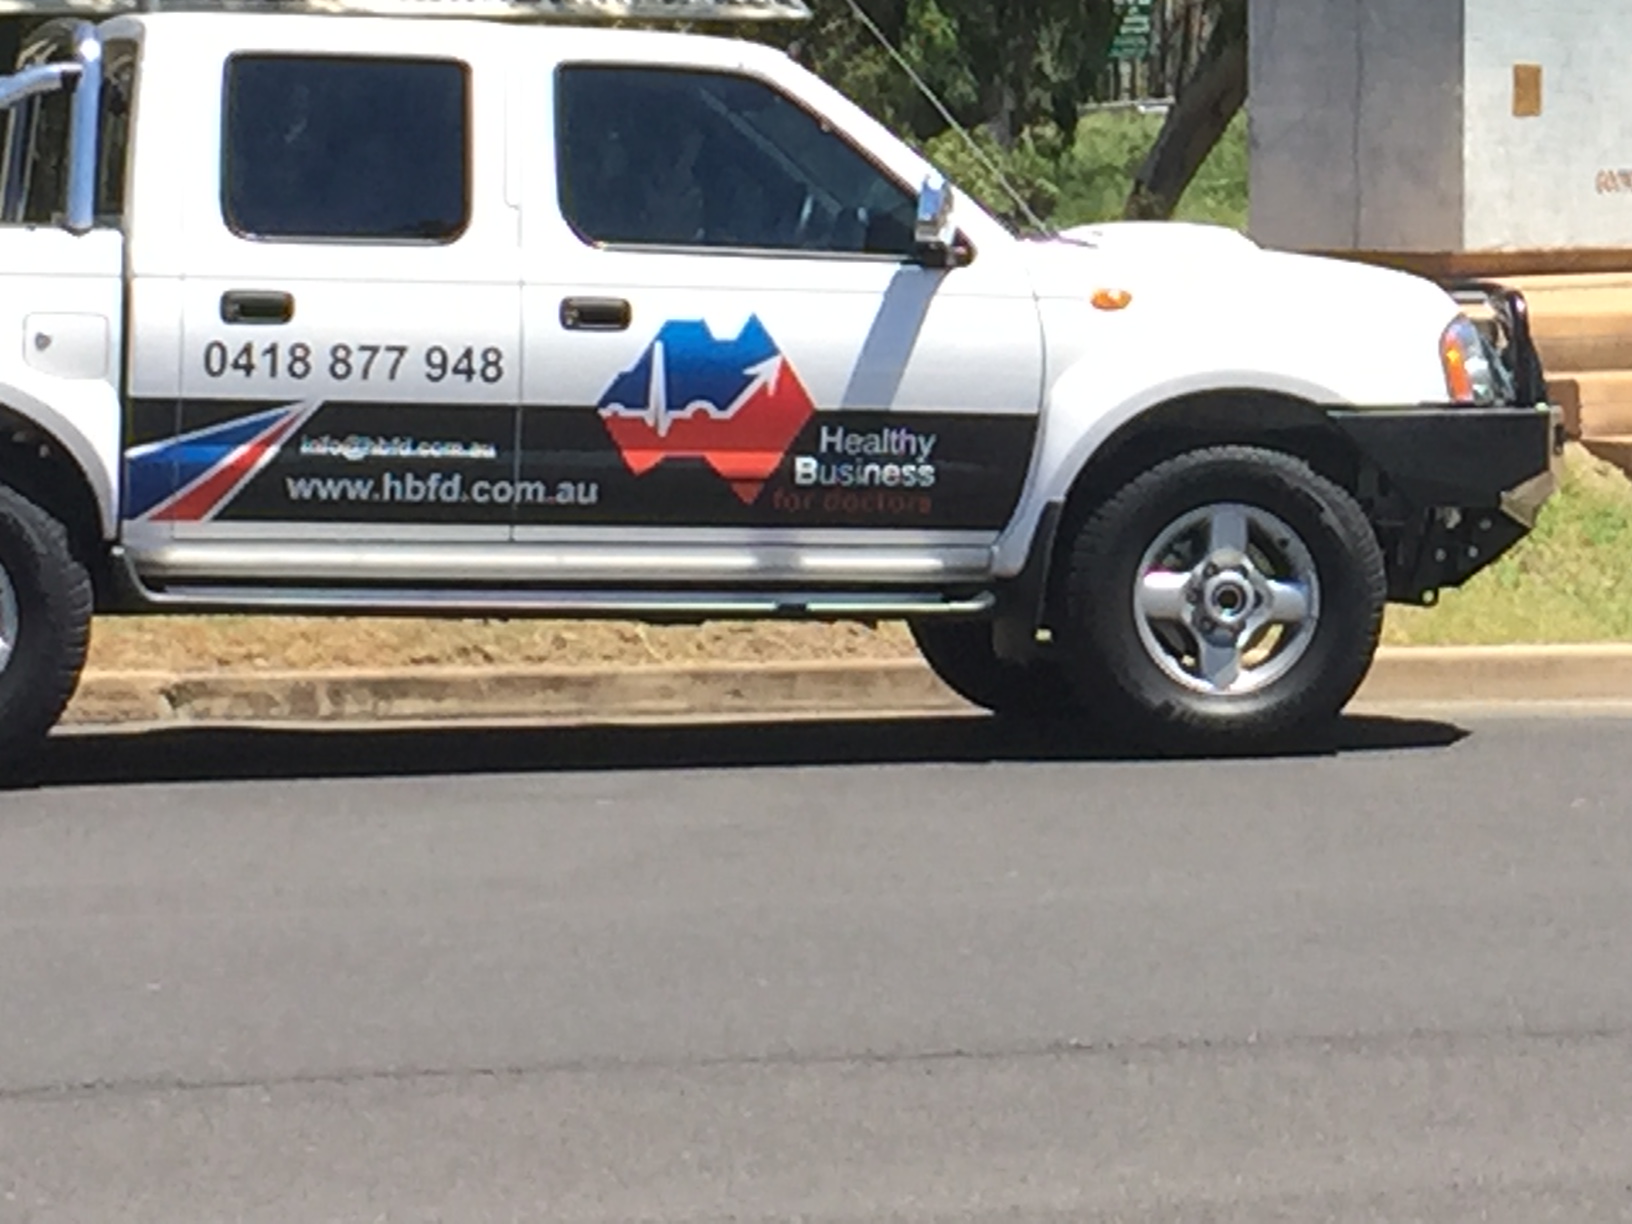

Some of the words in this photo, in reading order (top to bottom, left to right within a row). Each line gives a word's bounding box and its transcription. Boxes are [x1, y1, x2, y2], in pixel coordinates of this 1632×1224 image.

[204, 340, 312, 380] 0418
[329, 343, 408, 380] 877
[424, 346, 505, 384] 948
[819, 425, 937, 463] Healthy
[794, 456, 937, 487] Business
[285, 472, 599, 504] www.hbfd.com.au
[772, 487, 813, 512] for
[822, 487, 932, 514] doctors
